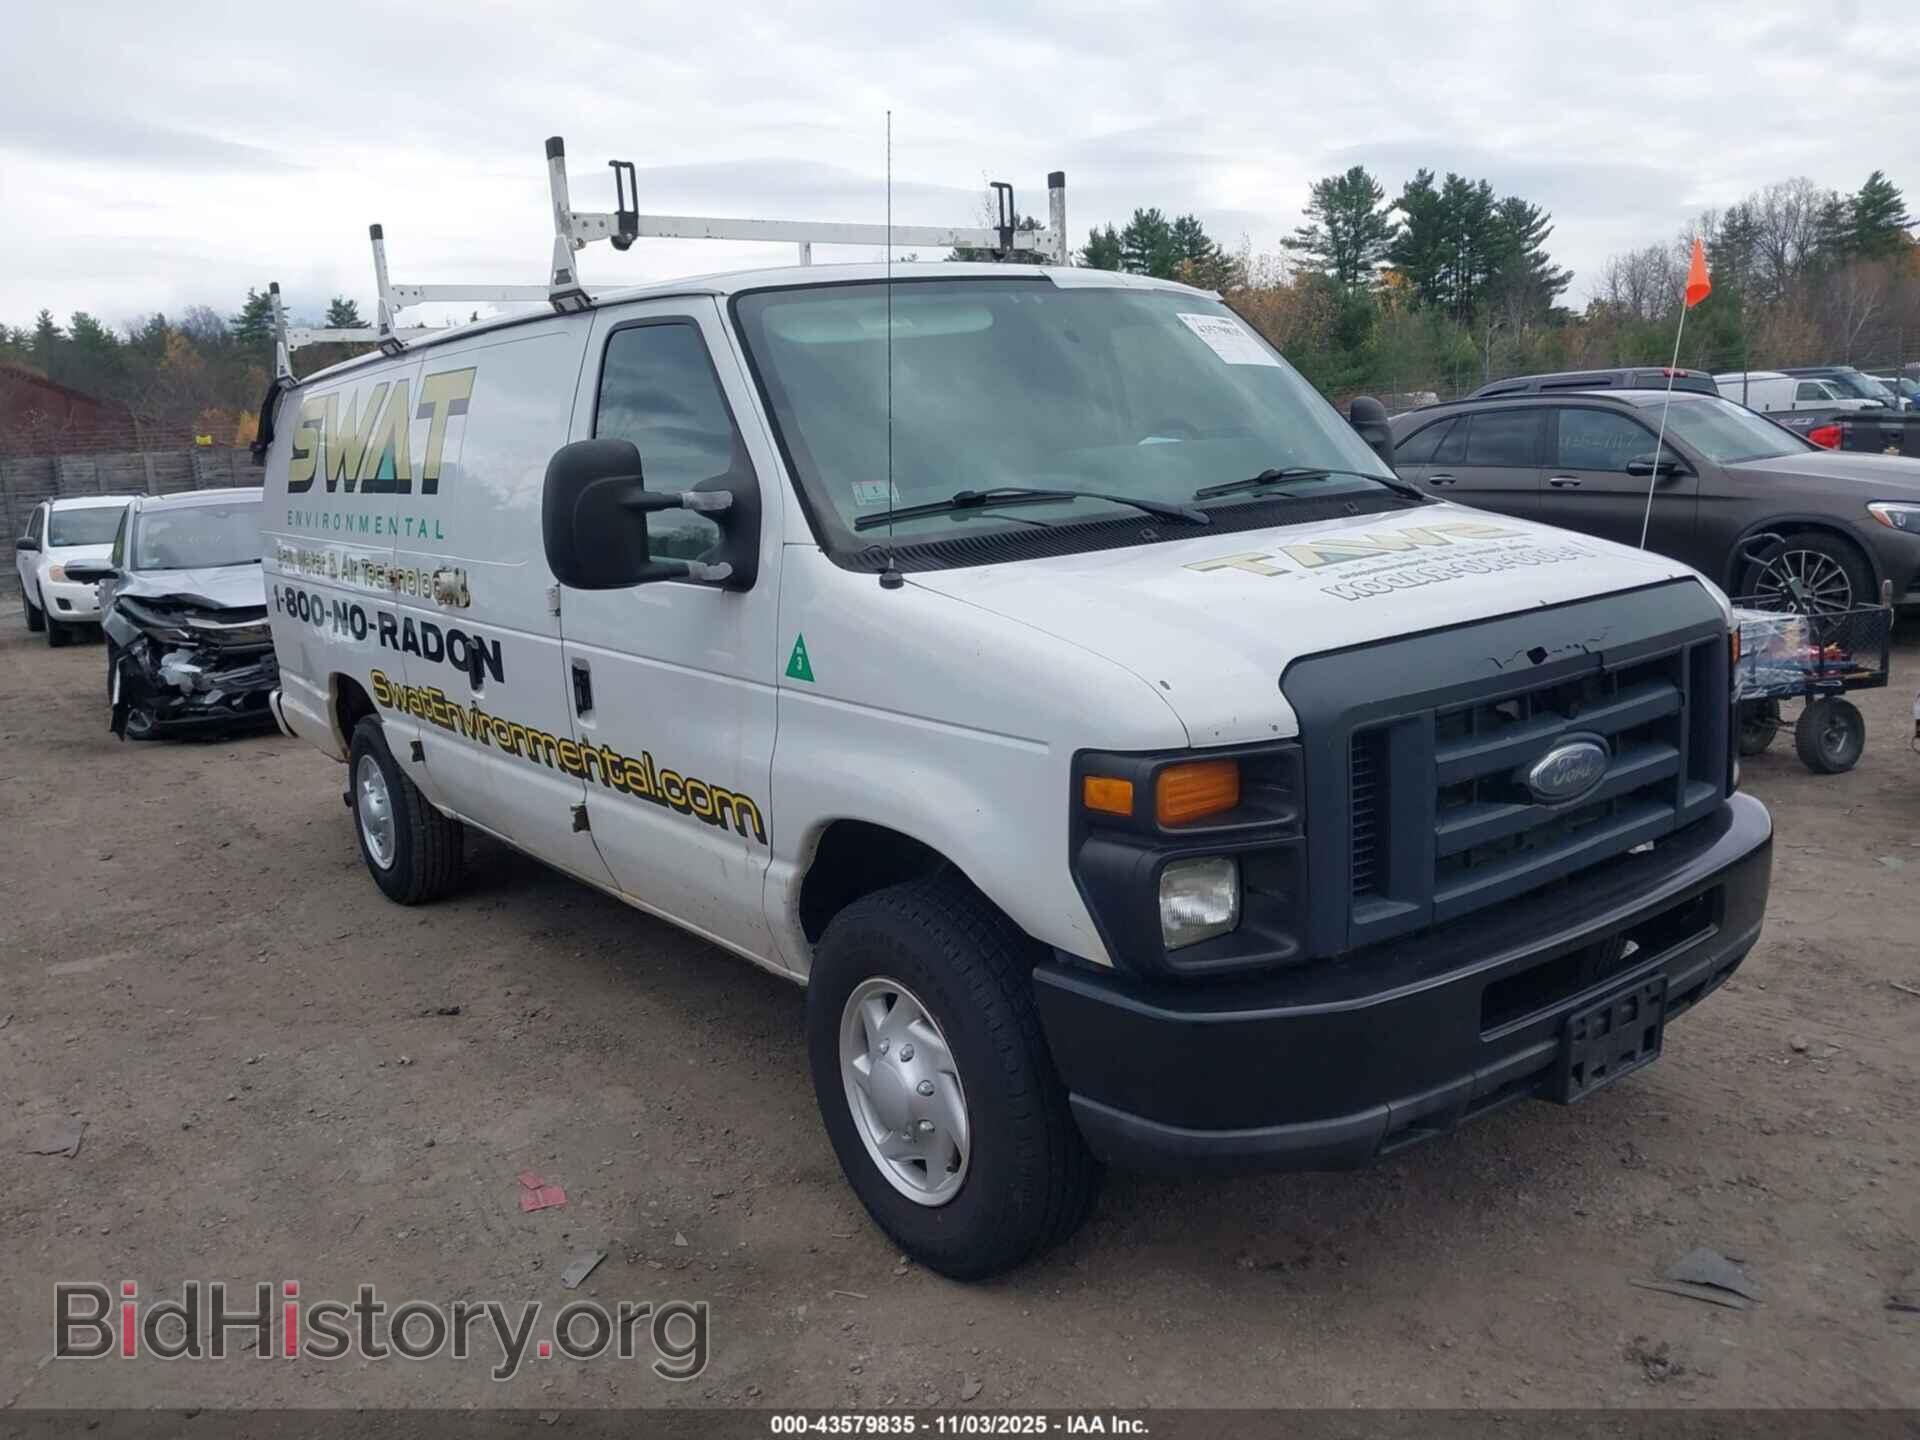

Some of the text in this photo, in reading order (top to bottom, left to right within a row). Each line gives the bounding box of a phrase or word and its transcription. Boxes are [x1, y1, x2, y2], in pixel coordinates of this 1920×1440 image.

[288, 366, 477, 494] SWAT
[288, 511, 444, 540] ENVIRONMENTAL
[274, 584, 504, 683] 1-800-NO-RADON
[370, 669, 768, 846] SwatEnvironmental.com
